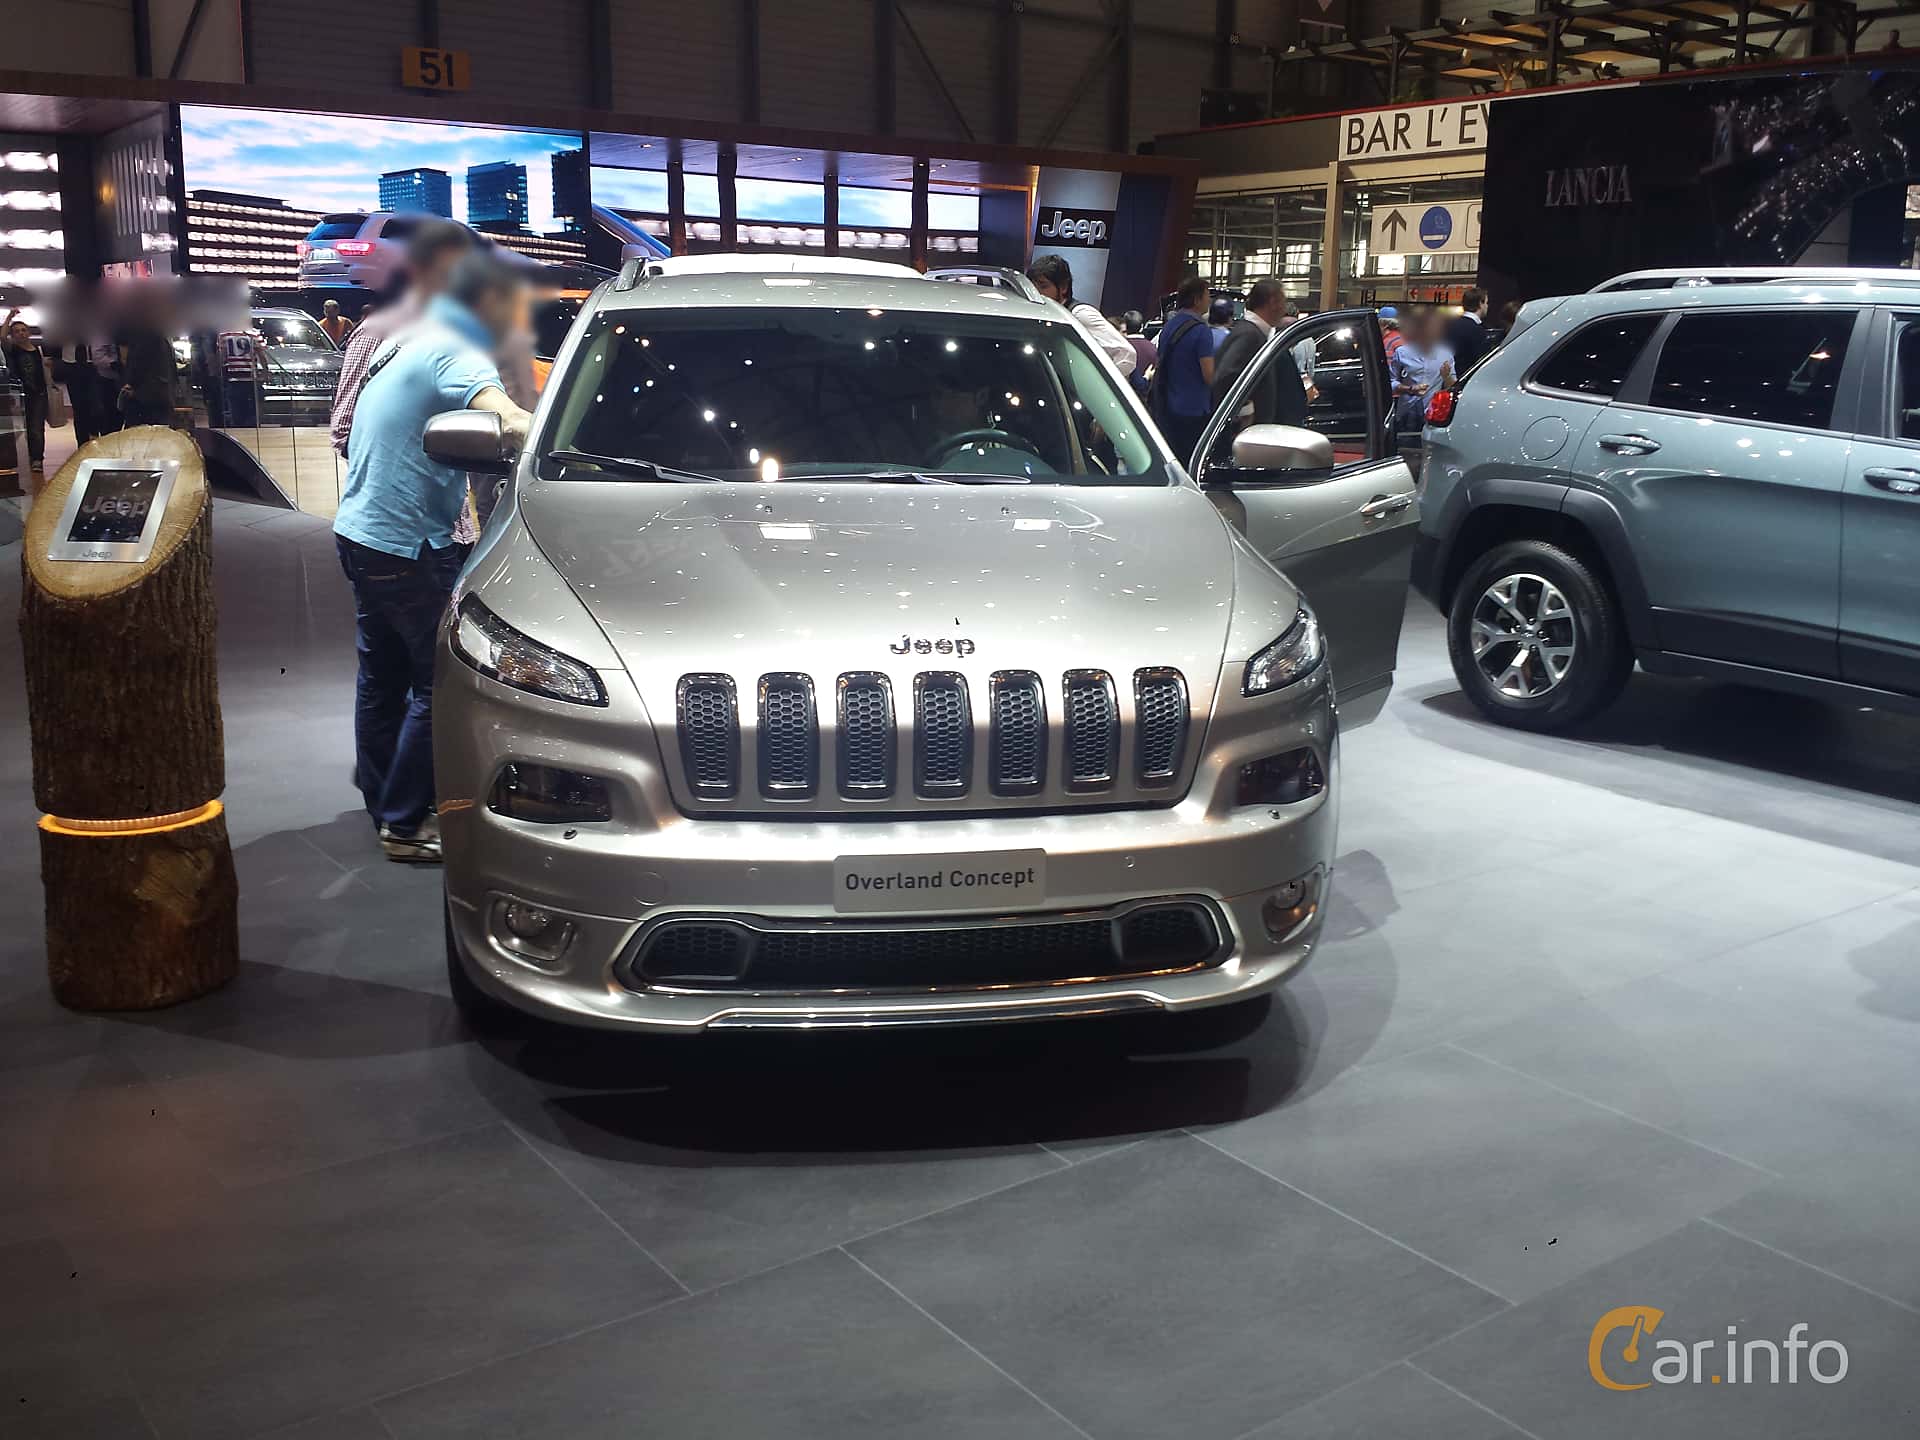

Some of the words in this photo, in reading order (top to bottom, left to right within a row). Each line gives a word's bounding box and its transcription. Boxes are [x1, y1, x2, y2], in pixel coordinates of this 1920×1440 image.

[420, 50, 454, 87] 51
[1346, 112, 1412, 156] BAR
[1544, 164, 1633, 207] LANCIA
[1041, 210, 1107, 246] Jeep
[227, 335, 251, 357] 19
[82, 496, 149, 518] Jeep
[82, 549, 113, 560] Jeep
[889, 634, 975, 659] Jeep
[845, 871, 943, 891] Overland
[950, 867, 1035, 888] Concept
